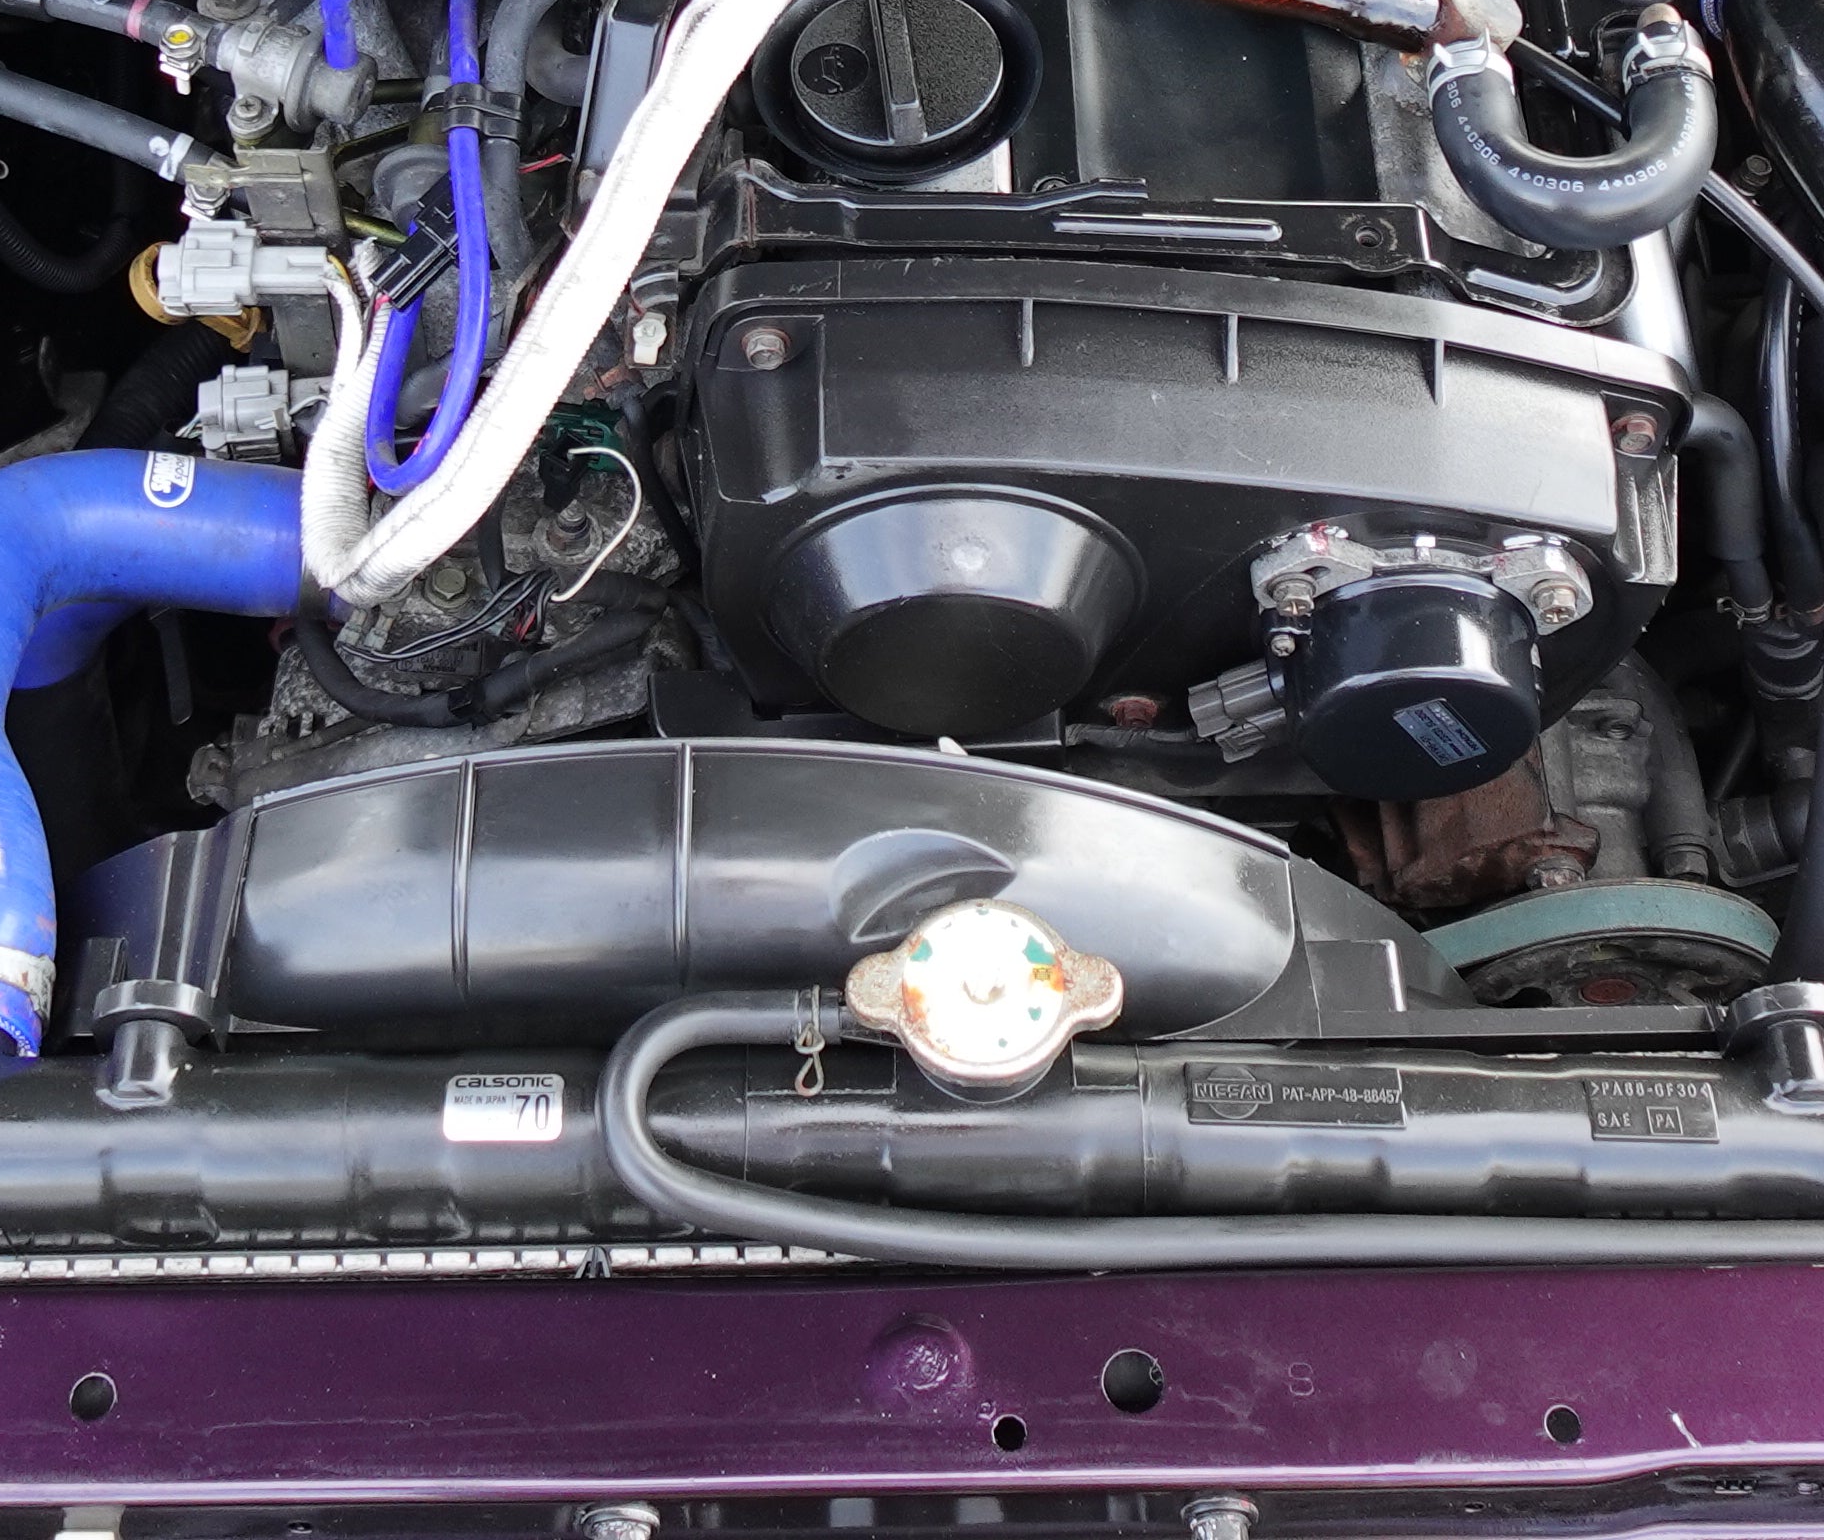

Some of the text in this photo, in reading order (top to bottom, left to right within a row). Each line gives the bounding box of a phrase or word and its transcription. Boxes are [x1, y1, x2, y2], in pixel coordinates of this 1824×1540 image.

[1194, 1082, 1267, 1101] NISSAN
[516, 1094, 550, 1131] 70
[1597, 1111, 1631, 1128] SAE
[1655, 1113, 1675, 1129] PA
